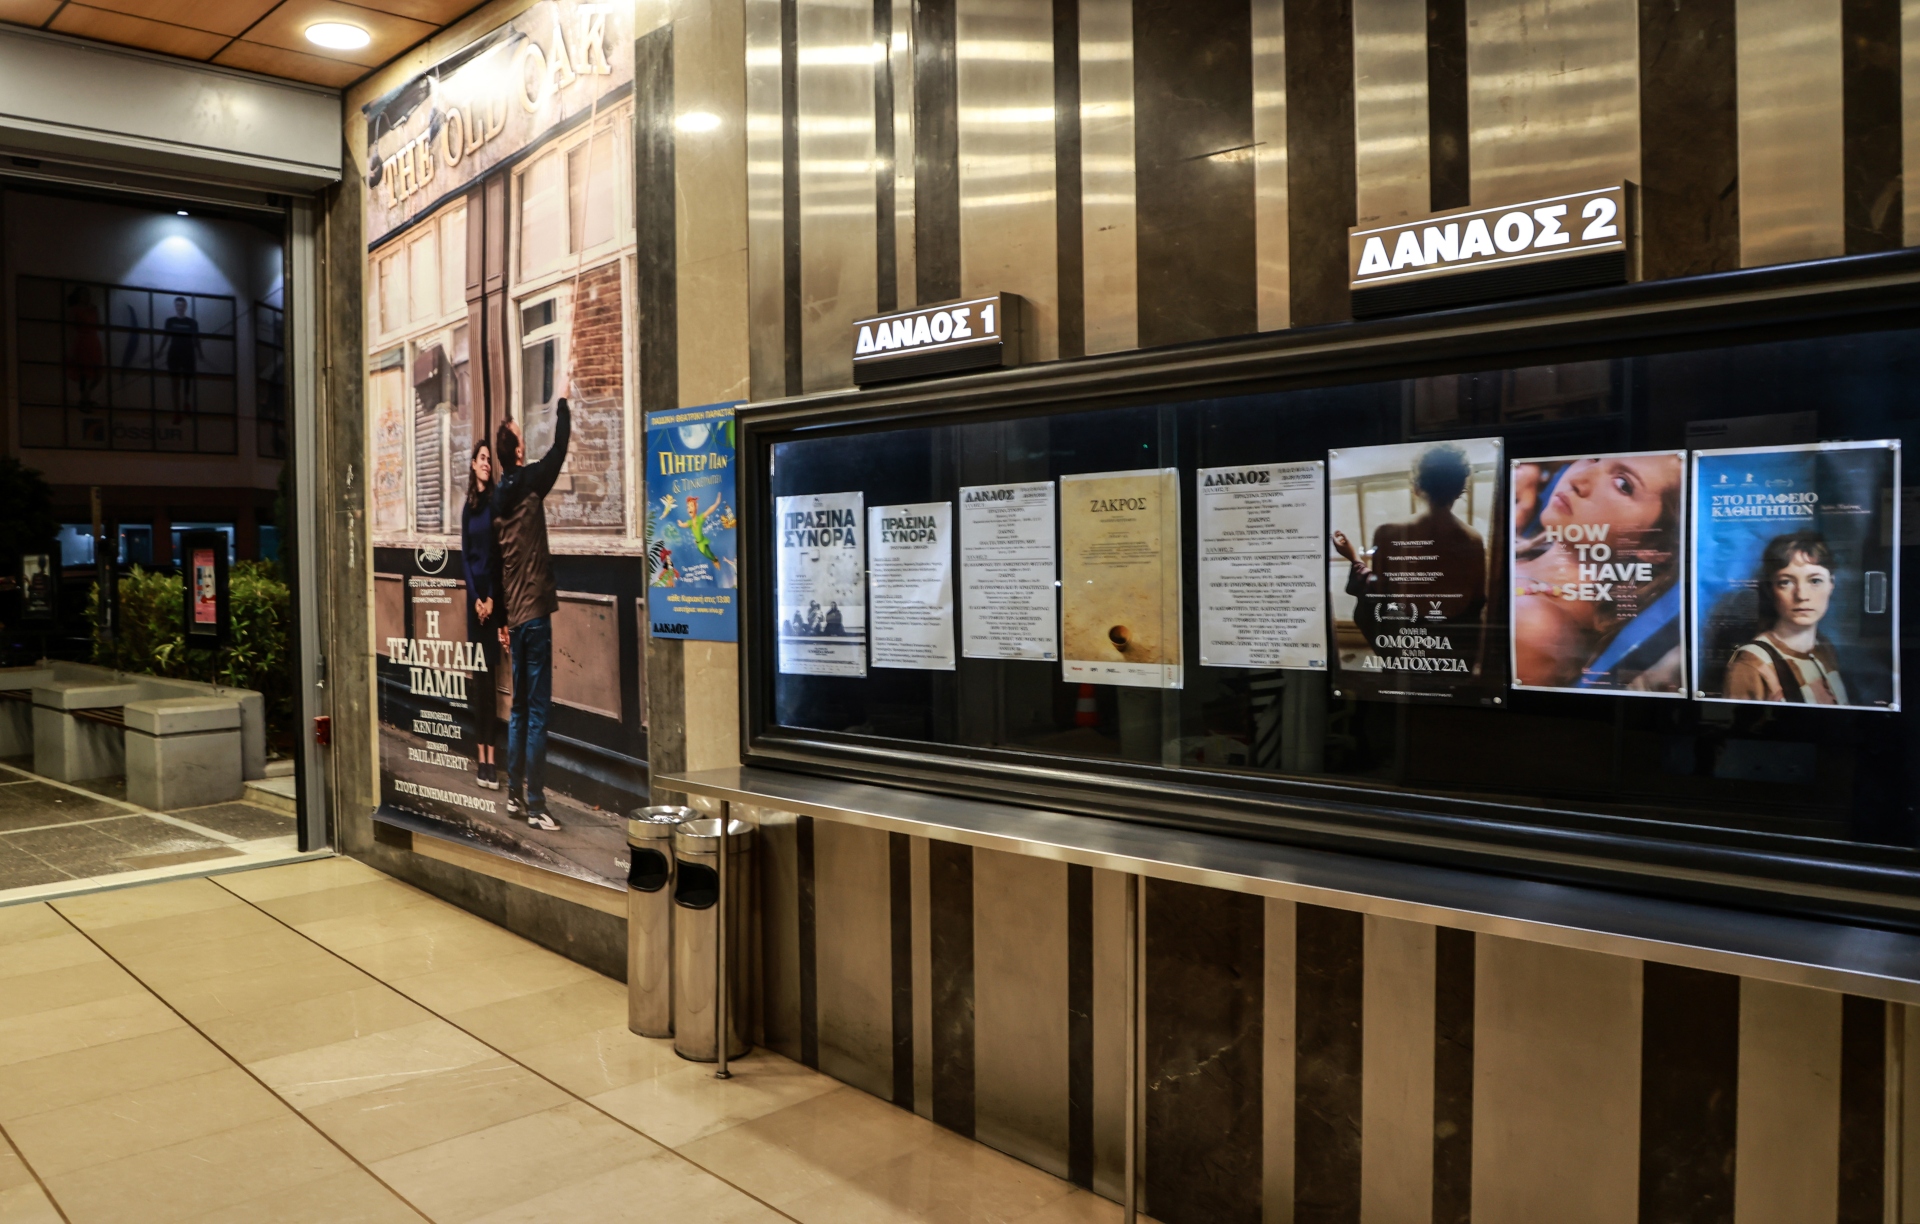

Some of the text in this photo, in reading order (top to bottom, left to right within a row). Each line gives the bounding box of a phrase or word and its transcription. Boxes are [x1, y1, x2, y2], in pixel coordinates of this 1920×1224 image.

[383, 3, 613, 209] THE OLD OAK
[1357, 197, 1617, 276] ΔΑΝΑΟΣ 2
[856, 304, 995, 354] ΔΑΝΑΟΣ 1
[1203, 470, 1270, 487] ΔΑΝΑΟΣ
[965, 489, 1015, 502] ΔΑΝΑΟΣ
[1090, 497, 1147, 513] ΖΑΚΡΟΣ
[1711, 492, 1819, 506] ΣΤΟ ΓΡΑΦΕΙΟ
[784, 509, 856, 530] ΠΡΑΣΙΝΑ
[1711, 504, 1814, 517] ΚΑΘΗΓΗΤΩΝ
[881, 516, 937, 530] ΠΡΑΣΙΝΑ
[784, 528, 856, 548] ΣΥΝΟΡΑ
[882, 529, 937, 543] ΣΥΝΟΡΑ
[1545, 523, 1611, 543] HOW
[1574, 543, 1612, 562] TO
[1578, 563, 1653, 581] HAVE
[1562, 583, 1613, 601] SEX
[425, 610, 440, 638] Η
[653, 623, 689, 635] ΔΑΝΑΟΣ
[1375, 634, 1453, 650] ΟΜΟΡΦΙΑ
[386, 637, 489, 672] ΤΕΛΕΥΤΑΙΑ
[1361, 655, 1470, 673] ΑΙΜΑΤΟΧΥΣΙΑ
[409, 667, 468, 700] ΠΑΜΠ
[412, 719, 462, 740] KEN LOACH
[408, 747, 469, 771] PAUL LAVERTY
[394, 779, 418, 795] ΣΤΟΥΣ
[418, 785, 497, 814] ΚΙΝΗΜΑΤΟΓΡΑΦΟΥΣ
